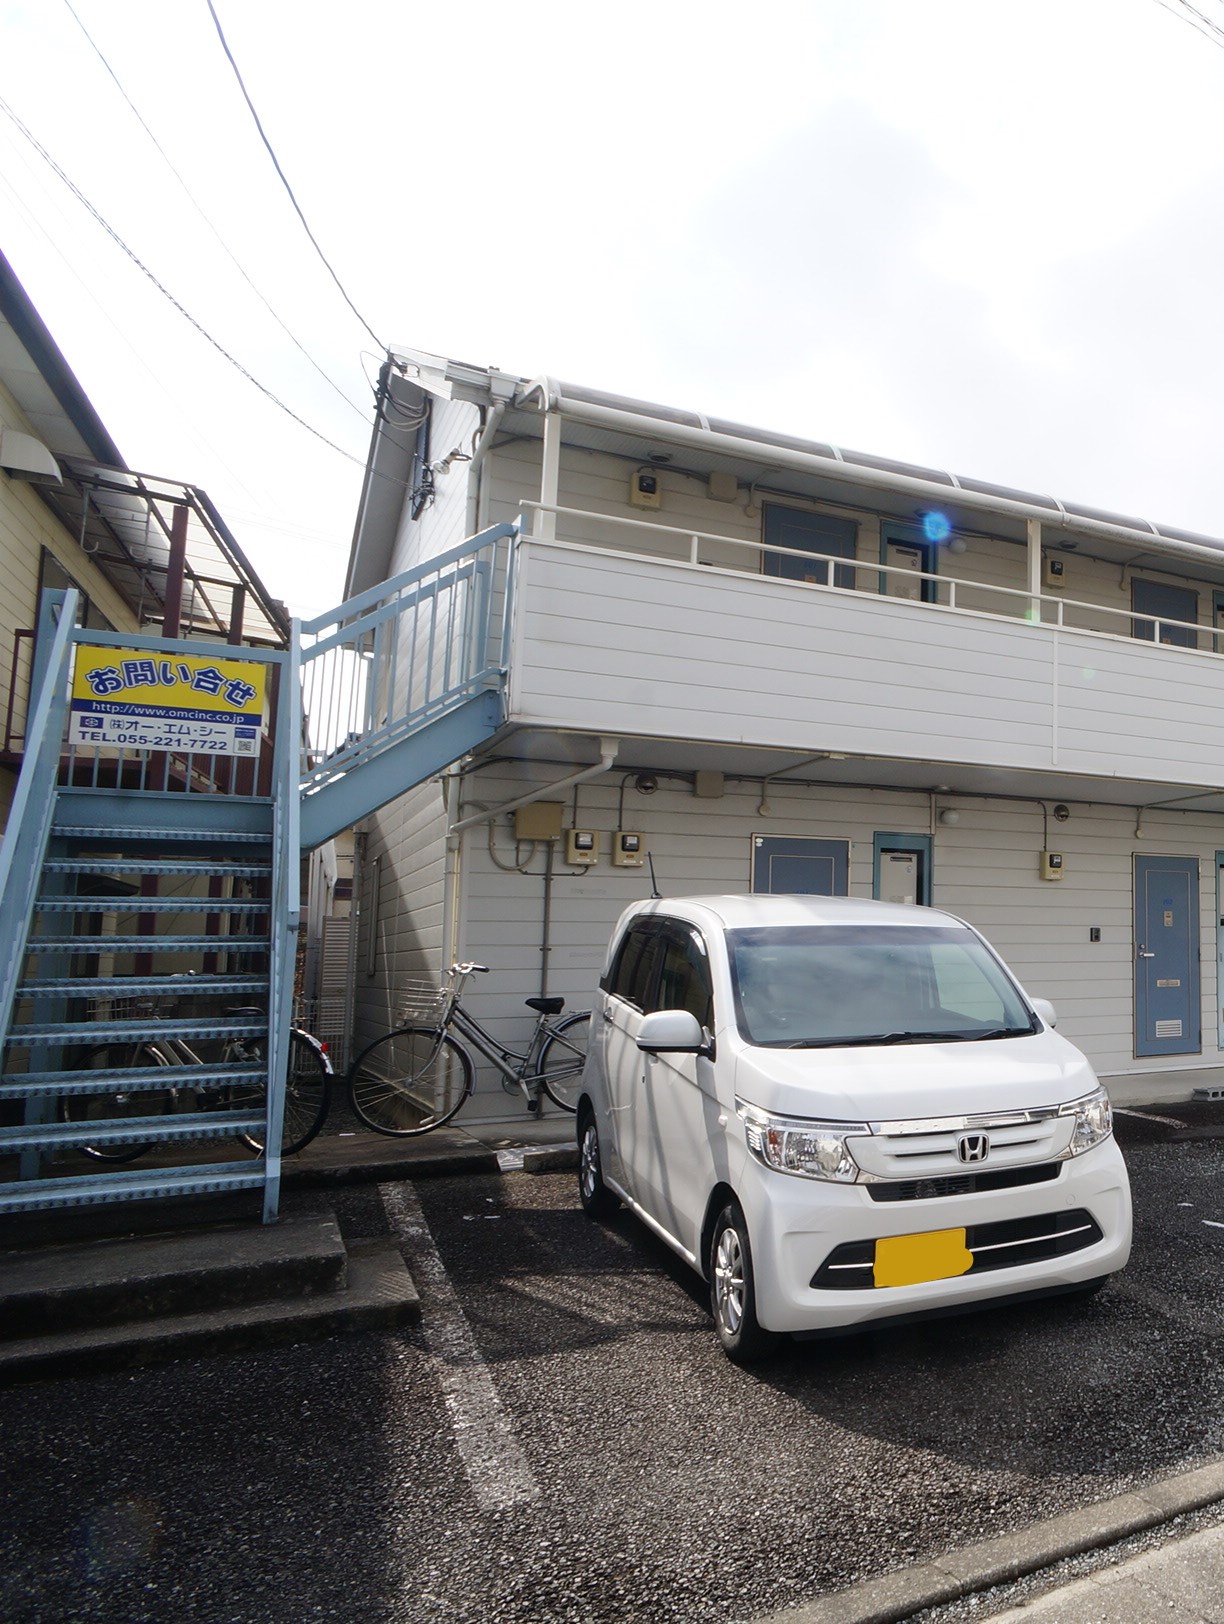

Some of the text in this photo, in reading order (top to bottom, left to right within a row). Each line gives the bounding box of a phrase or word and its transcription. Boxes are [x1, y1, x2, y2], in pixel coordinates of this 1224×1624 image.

[86, 659, 256, 707] お問い合せ
[92, 702, 244, 723] http://www.omcinc.co.jp
[78, 730, 228, 751] TEL.055-221-7722
